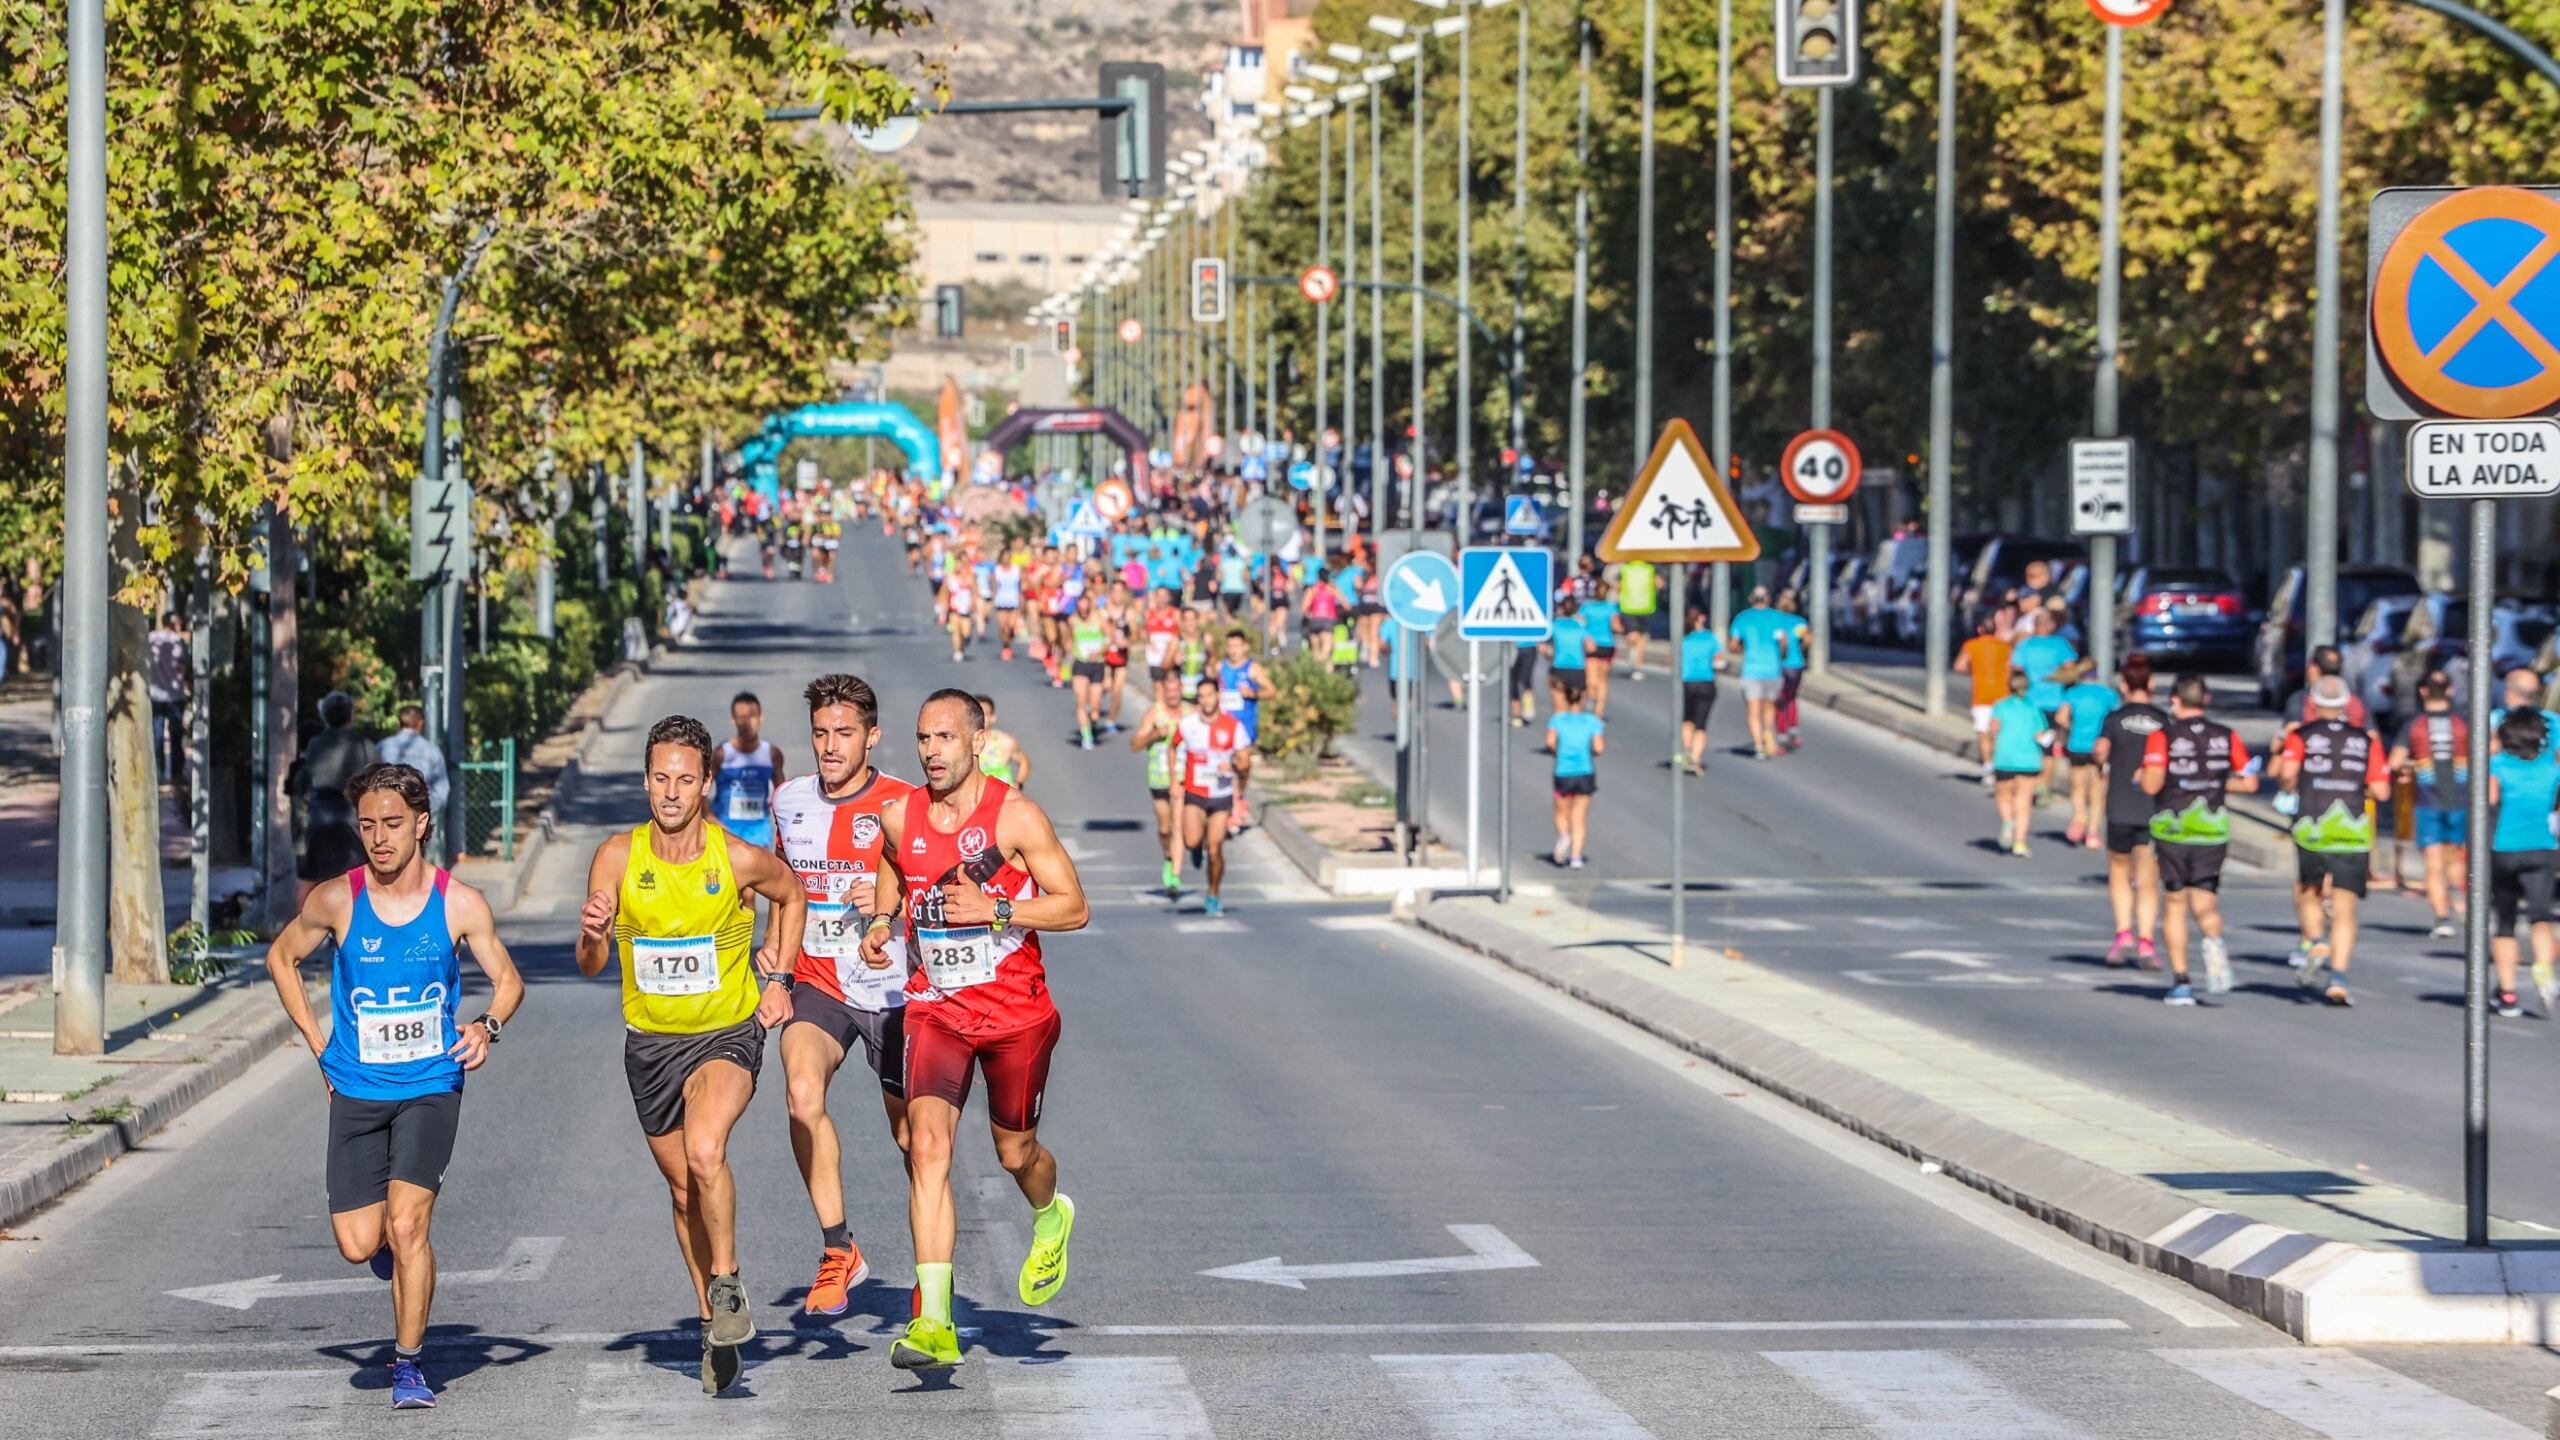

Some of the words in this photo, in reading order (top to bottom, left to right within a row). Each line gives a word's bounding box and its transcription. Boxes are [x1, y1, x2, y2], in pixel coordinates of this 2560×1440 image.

[2429, 433, 2463, 454] EN
[2474, 432, 2546, 453] TODA
[1799, 455, 1843, 480] 40
[2428, 465, 2461, 486] LA
[2472, 464, 2547, 485] AVDA.
[792, 859, 864, 871] CONECTA-3
[818, 920, 845, 936] 13
[653, 956, 699, 974] 170
[932, 945, 976, 966] 283
[378, 1021, 425, 1042] 188
